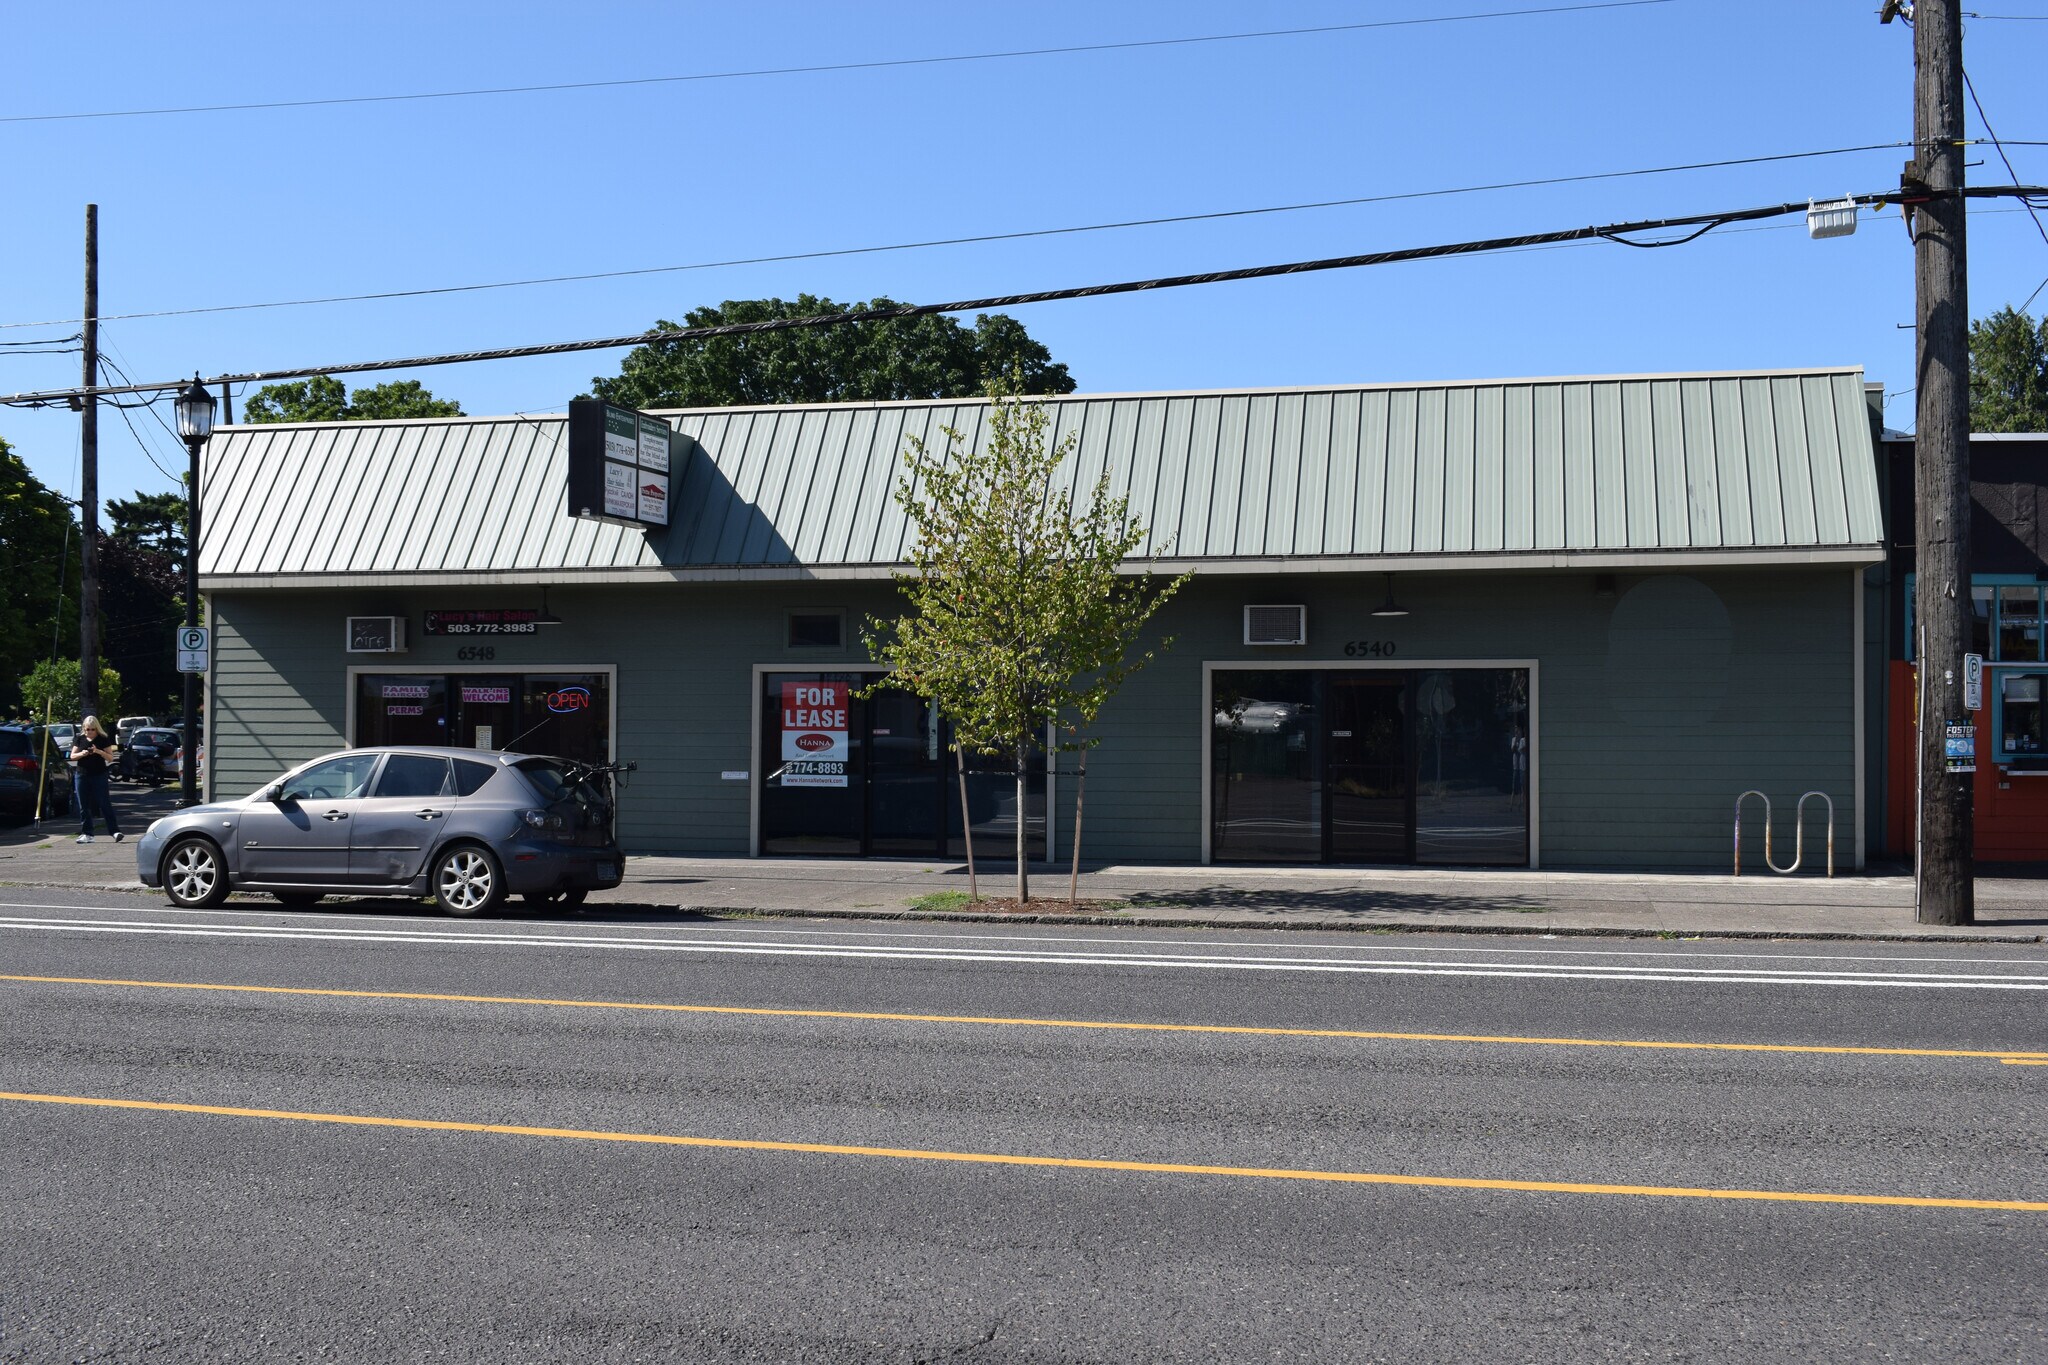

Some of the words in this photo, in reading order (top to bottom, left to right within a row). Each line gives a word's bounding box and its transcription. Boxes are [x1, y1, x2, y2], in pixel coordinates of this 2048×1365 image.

[440, 612, 475, 623] Lucy's
[477, 611, 500, 621] Hair
[503, 610, 536, 621] Salon
[447, 624, 535, 633] 503-772-3983
[189, 634, 200, 646] P
[458, 646, 495, 660] 6548
[1344, 641, 1396, 657] 6540
[463, 693, 509, 702] WELCOME
[548, 692, 589, 708] OPEN
[796, 688, 835, 706] FOR
[388, 706, 423, 715] PERMS
[785, 709, 845, 727] LEASE
[794, 762, 844, 774] 774-8893
